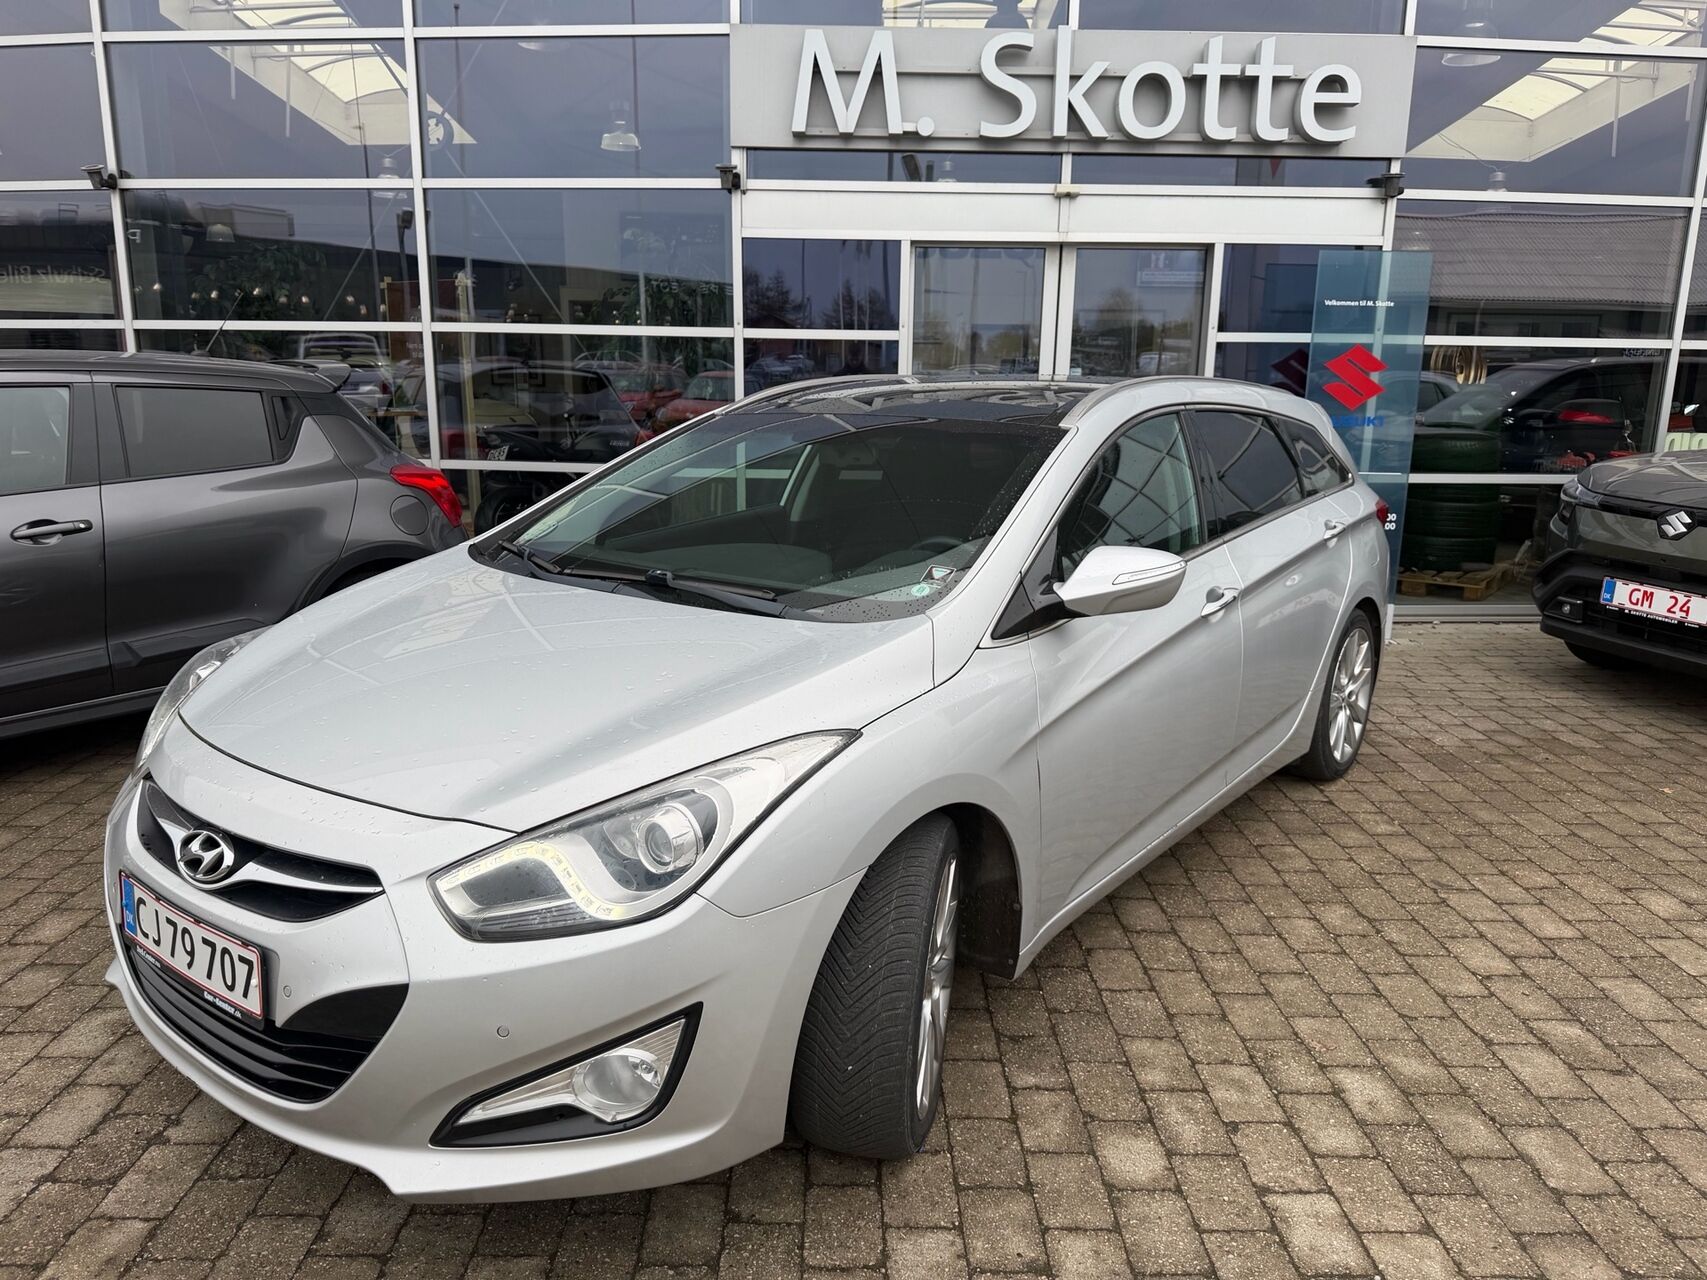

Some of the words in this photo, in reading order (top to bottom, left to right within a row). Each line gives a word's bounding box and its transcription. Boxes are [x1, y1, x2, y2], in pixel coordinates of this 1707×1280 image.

[791, 28, 935, 138] M.
[979, 25, 1362, 144] Skotte
[1628, 588, 1655, 609] GM
[1666, 595, 1692, 617] 24
[126, 910, 135, 926] DK
